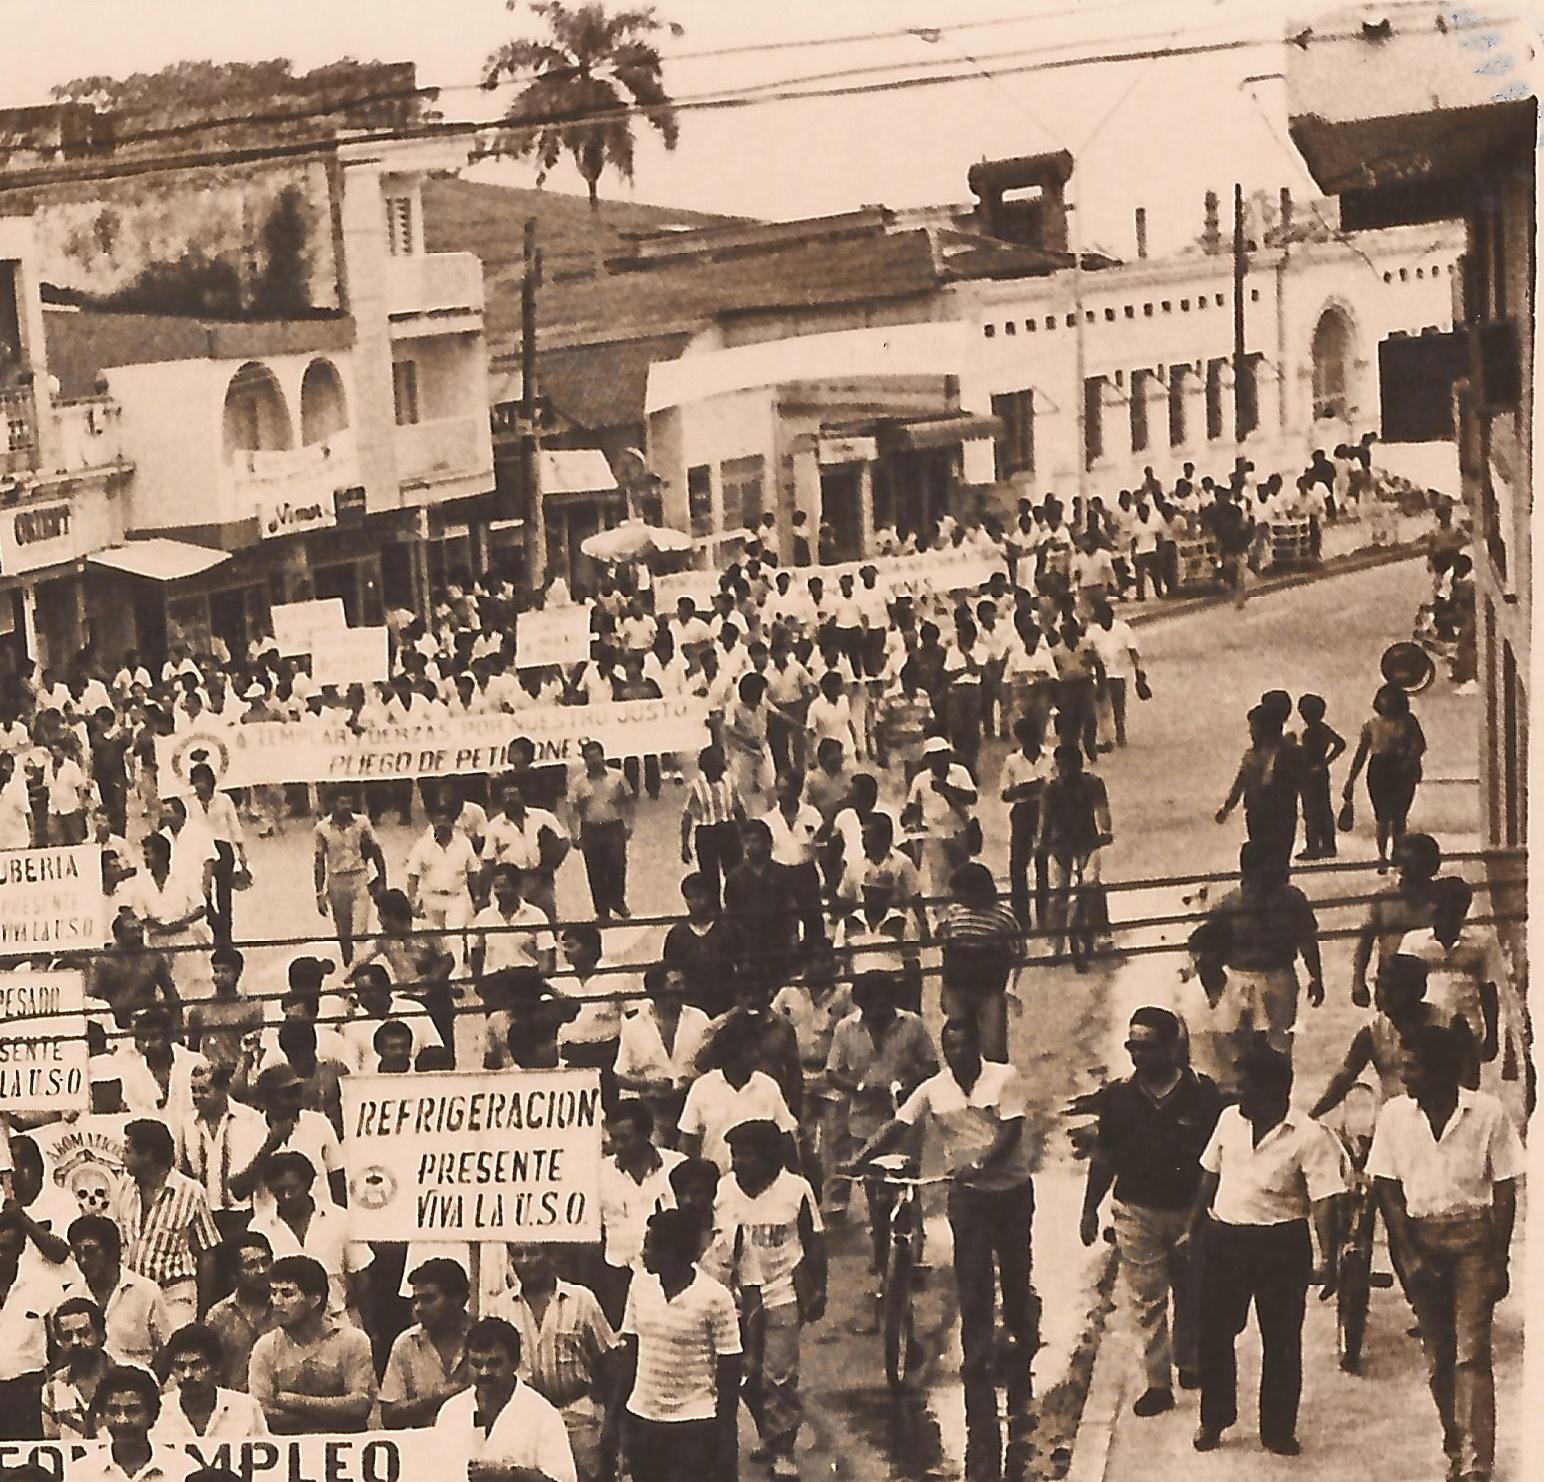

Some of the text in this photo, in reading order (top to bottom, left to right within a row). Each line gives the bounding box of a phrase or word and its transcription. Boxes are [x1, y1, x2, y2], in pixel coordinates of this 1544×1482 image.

[329, 750, 413, 776] PLIEGO
[418, 749, 448, 773] DE
[0, 1069, 22, 1099] LA
[355, 1087, 600, 1138] REFRIGERACION
[416, 1147, 565, 1185] PRESENTE
[416, 1188, 464, 1229] VIVA
[473, 1193, 505, 1228] LA
